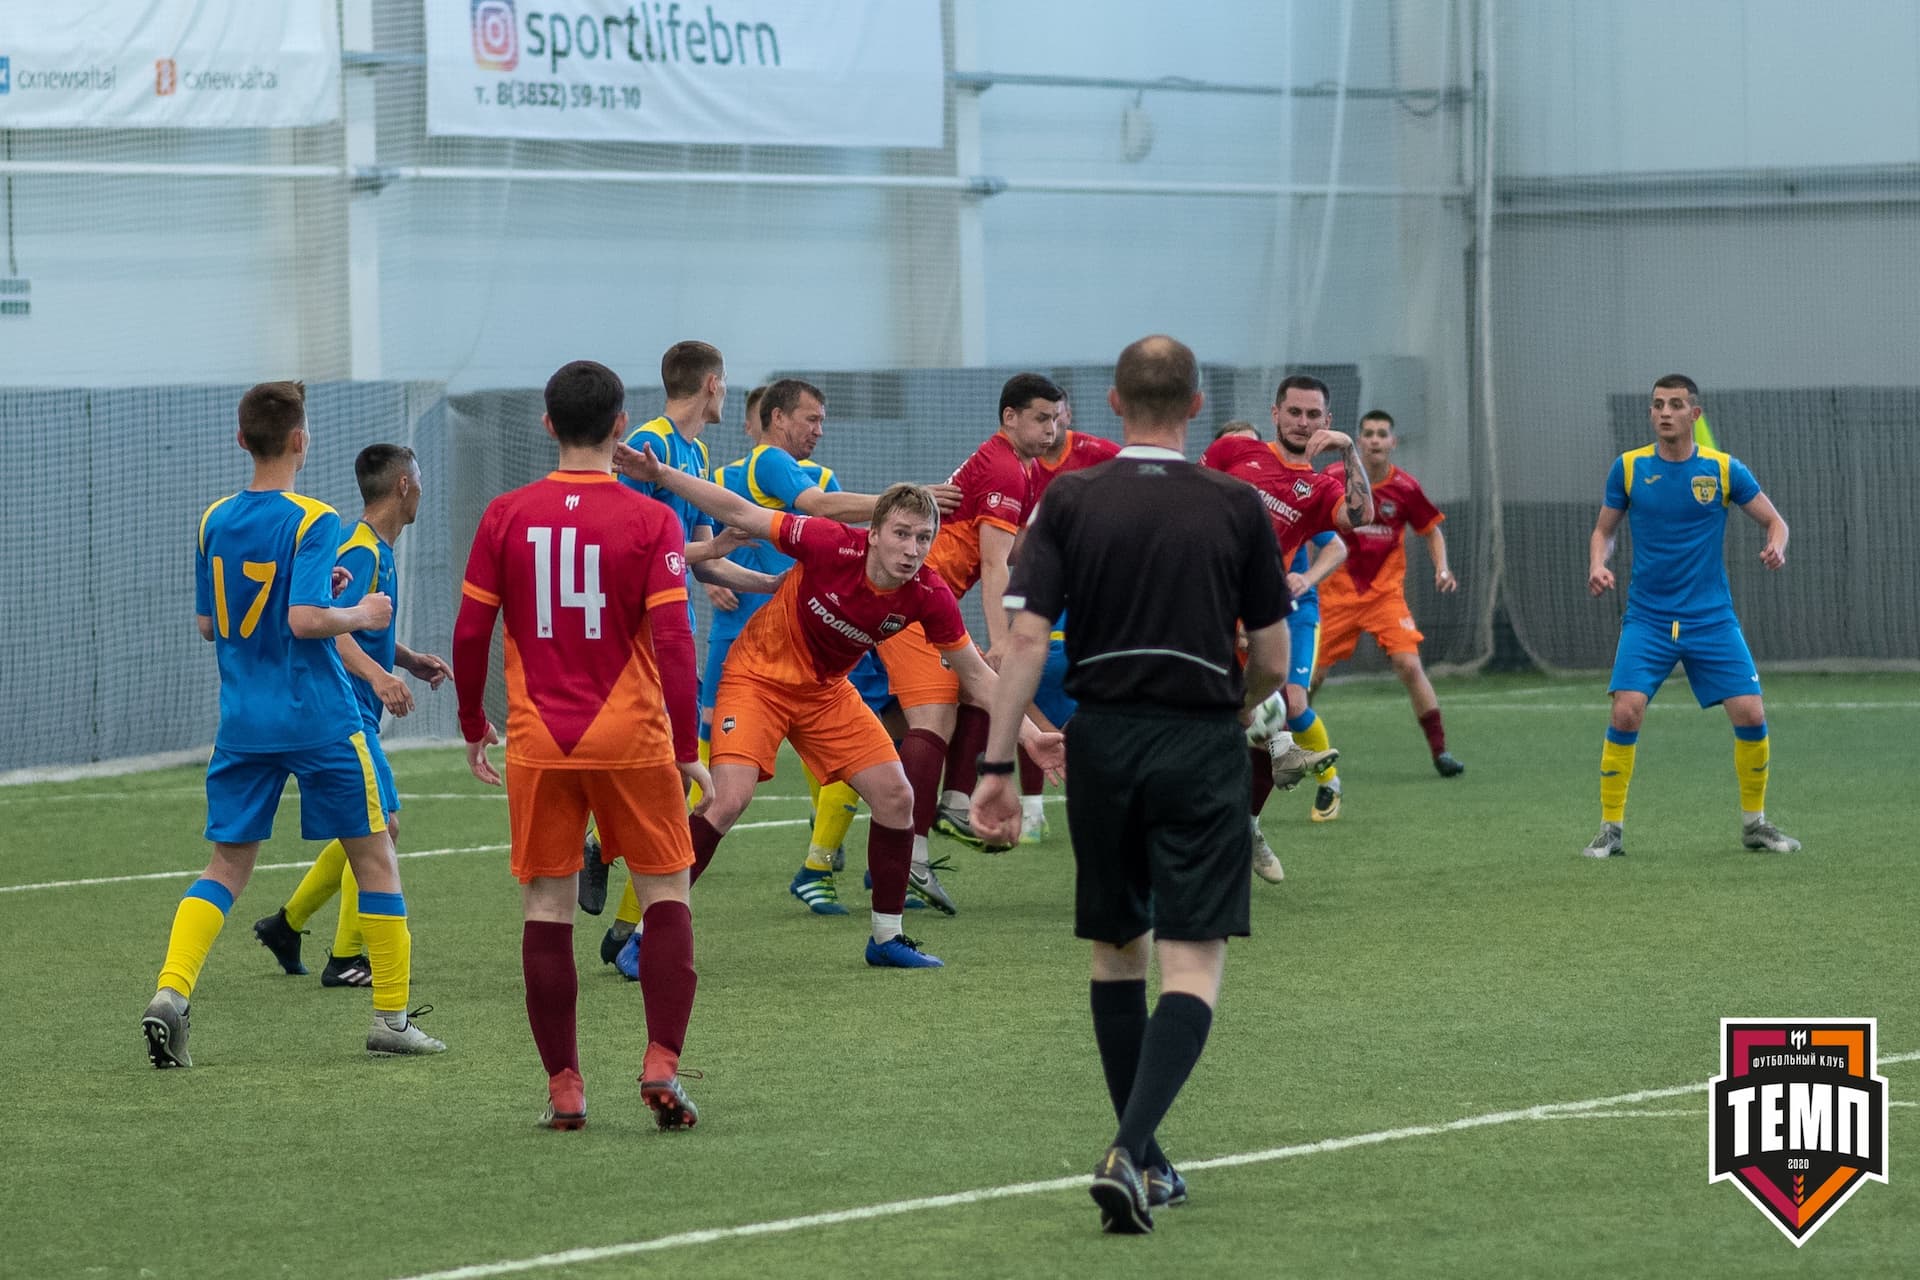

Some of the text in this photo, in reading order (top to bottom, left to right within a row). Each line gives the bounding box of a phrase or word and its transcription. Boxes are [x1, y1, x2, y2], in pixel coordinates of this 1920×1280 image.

[526, 1, 780, 73] sportlifebrn
[497, 81, 567, 111] 8(3852)
[571, 84, 641, 110] 59-11-10
[212, 556, 277, 639] 17
[527, 527, 606, 639] 14
